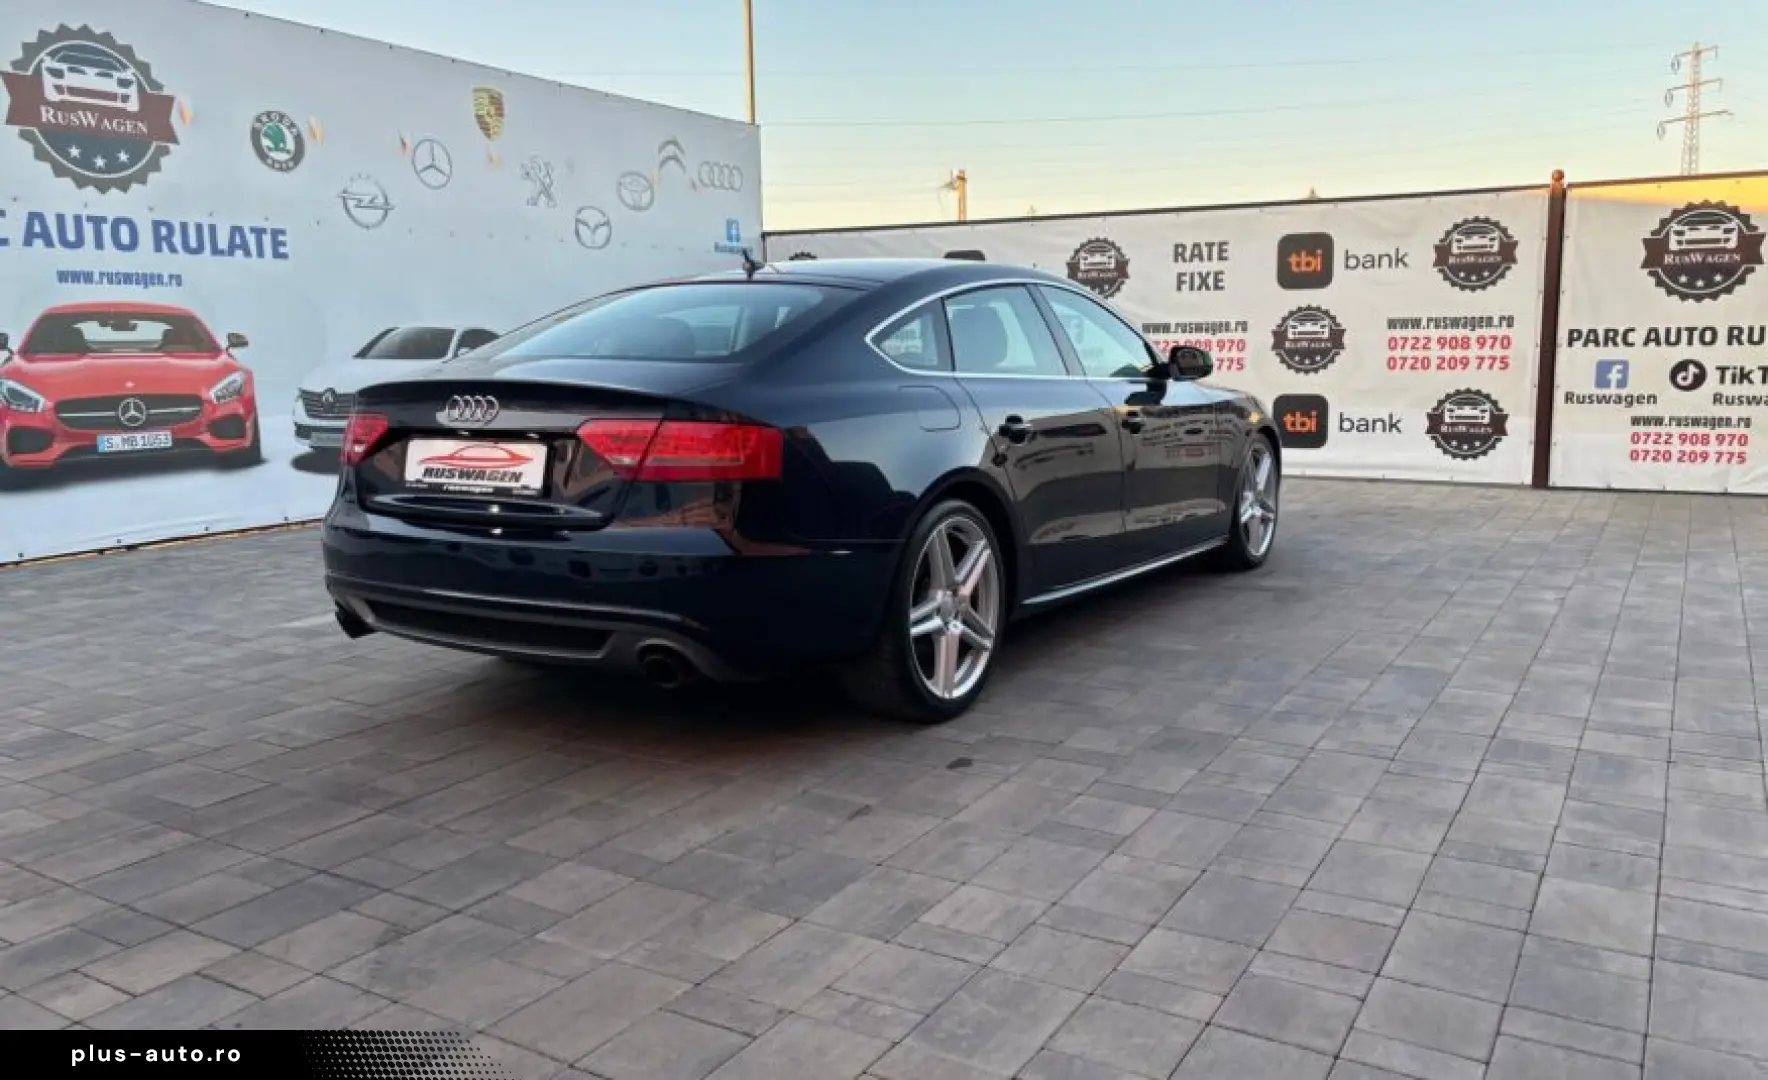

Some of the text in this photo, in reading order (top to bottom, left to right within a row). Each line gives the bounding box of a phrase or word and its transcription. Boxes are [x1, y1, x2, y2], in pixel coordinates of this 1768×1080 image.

[22, 211, 139, 252] AUTO
[152, 219, 289, 260] RULATE
[1173, 241, 1230, 264] RATE
[1287, 248, 1411, 272] tbi bank
[56, 268, 183, 289] www.ruswagen.ro
[1176, 271, 1226, 292] FIXE
[1386, 315, 1515, 331] www.ruswagen.ro
[1216, 338, 1246, 352] 970
[1387, 335, 1512, 351] 0722 908 970
[1567, 328, 1635, 348] PARC
[1642, 327, 1718, 347] AUTO
[1215, 357, 1246, 370] 775
[1386, 356, 1510, 371] 0720 209 775
[1564, 391, 1658, 409] Ruswagen
[1283, 411, 1402, 434] tbi bank
[1630, 415, 1752, 430] www.ruswagen.ro
[1630, 432, 1749, 447] 0722 908 970
[1629, 450, 1747, 465] 0720 209 775
[422, 467, 524, 483] RUSWAGEN
